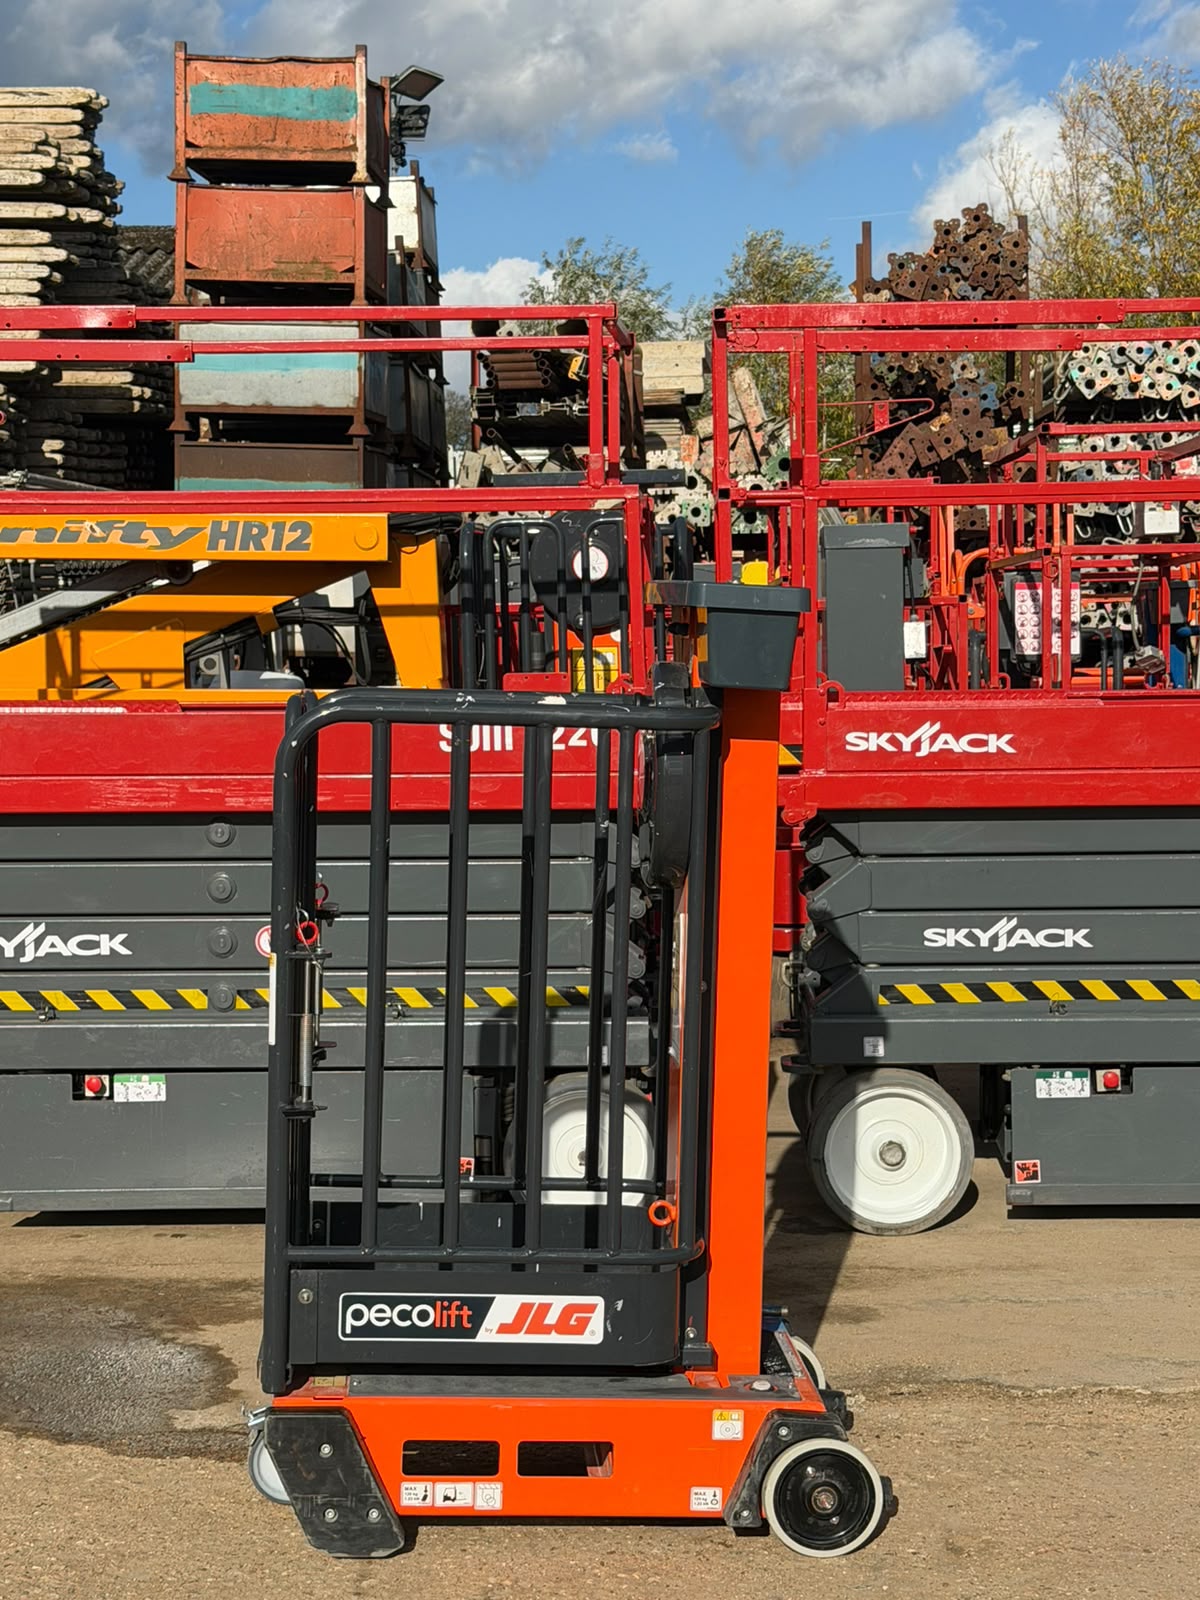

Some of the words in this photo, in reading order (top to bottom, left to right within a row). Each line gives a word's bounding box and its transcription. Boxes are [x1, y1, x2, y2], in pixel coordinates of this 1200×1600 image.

[0, 520, 206, 550] nifty
[206, 520, 312, 552] HR12
[845, 721, 1017, 757] SKYJACK
[923, 916, 1094, 952] SKYJACK
[345, 1300, 472, 1334] pecolift
[484, 1326, 494, 1334] by
[495, 1302, 599, 1336] JLG
